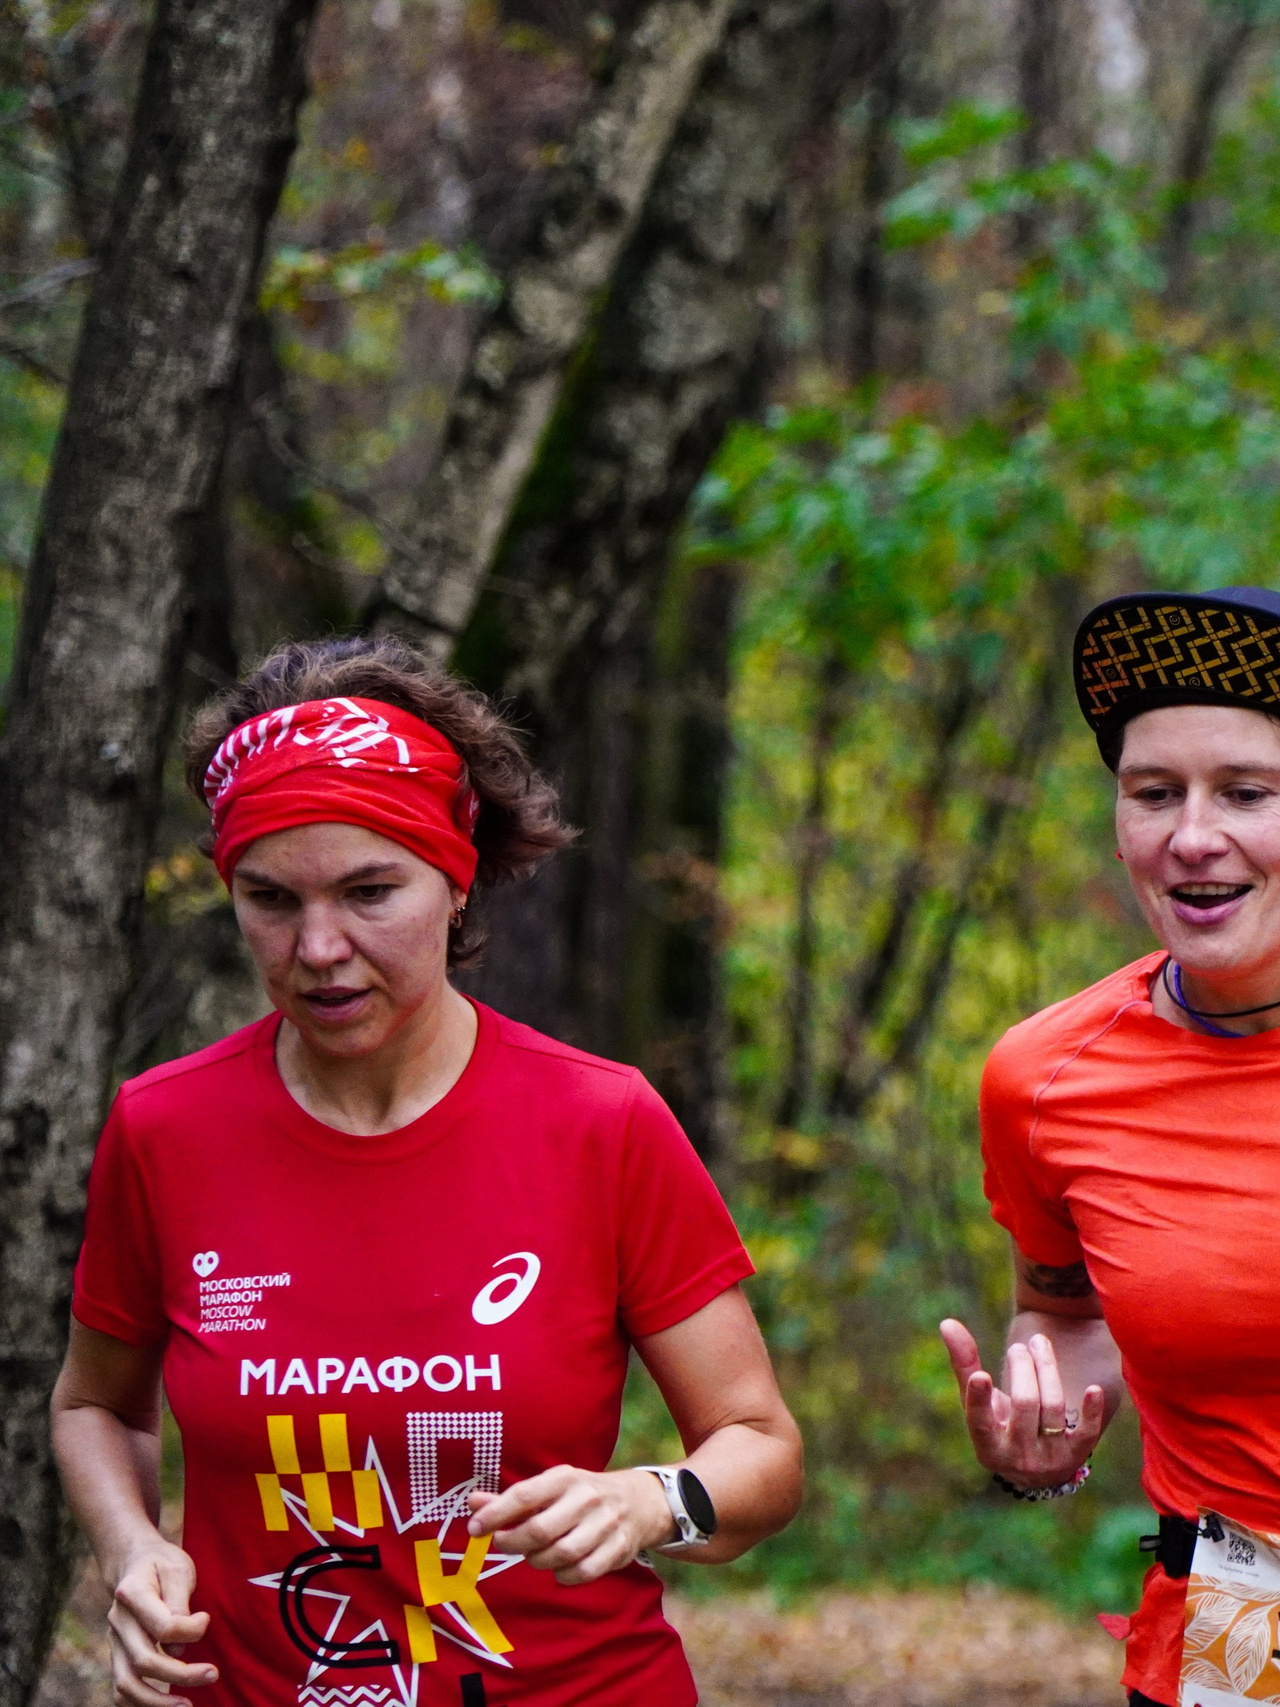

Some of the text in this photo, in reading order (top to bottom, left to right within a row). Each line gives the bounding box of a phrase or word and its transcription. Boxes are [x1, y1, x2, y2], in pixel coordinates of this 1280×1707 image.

[199, 1272, 291, 1293] МОСКОВСКИЙ
[199, 1290, 262, 1307] МАРАФОН
[200, 1304, 254, 1320] MOSCOW
[198, 1318, 267, 1333] MARATHON
[239, 1354, 502, 1396] МАРАФОН
